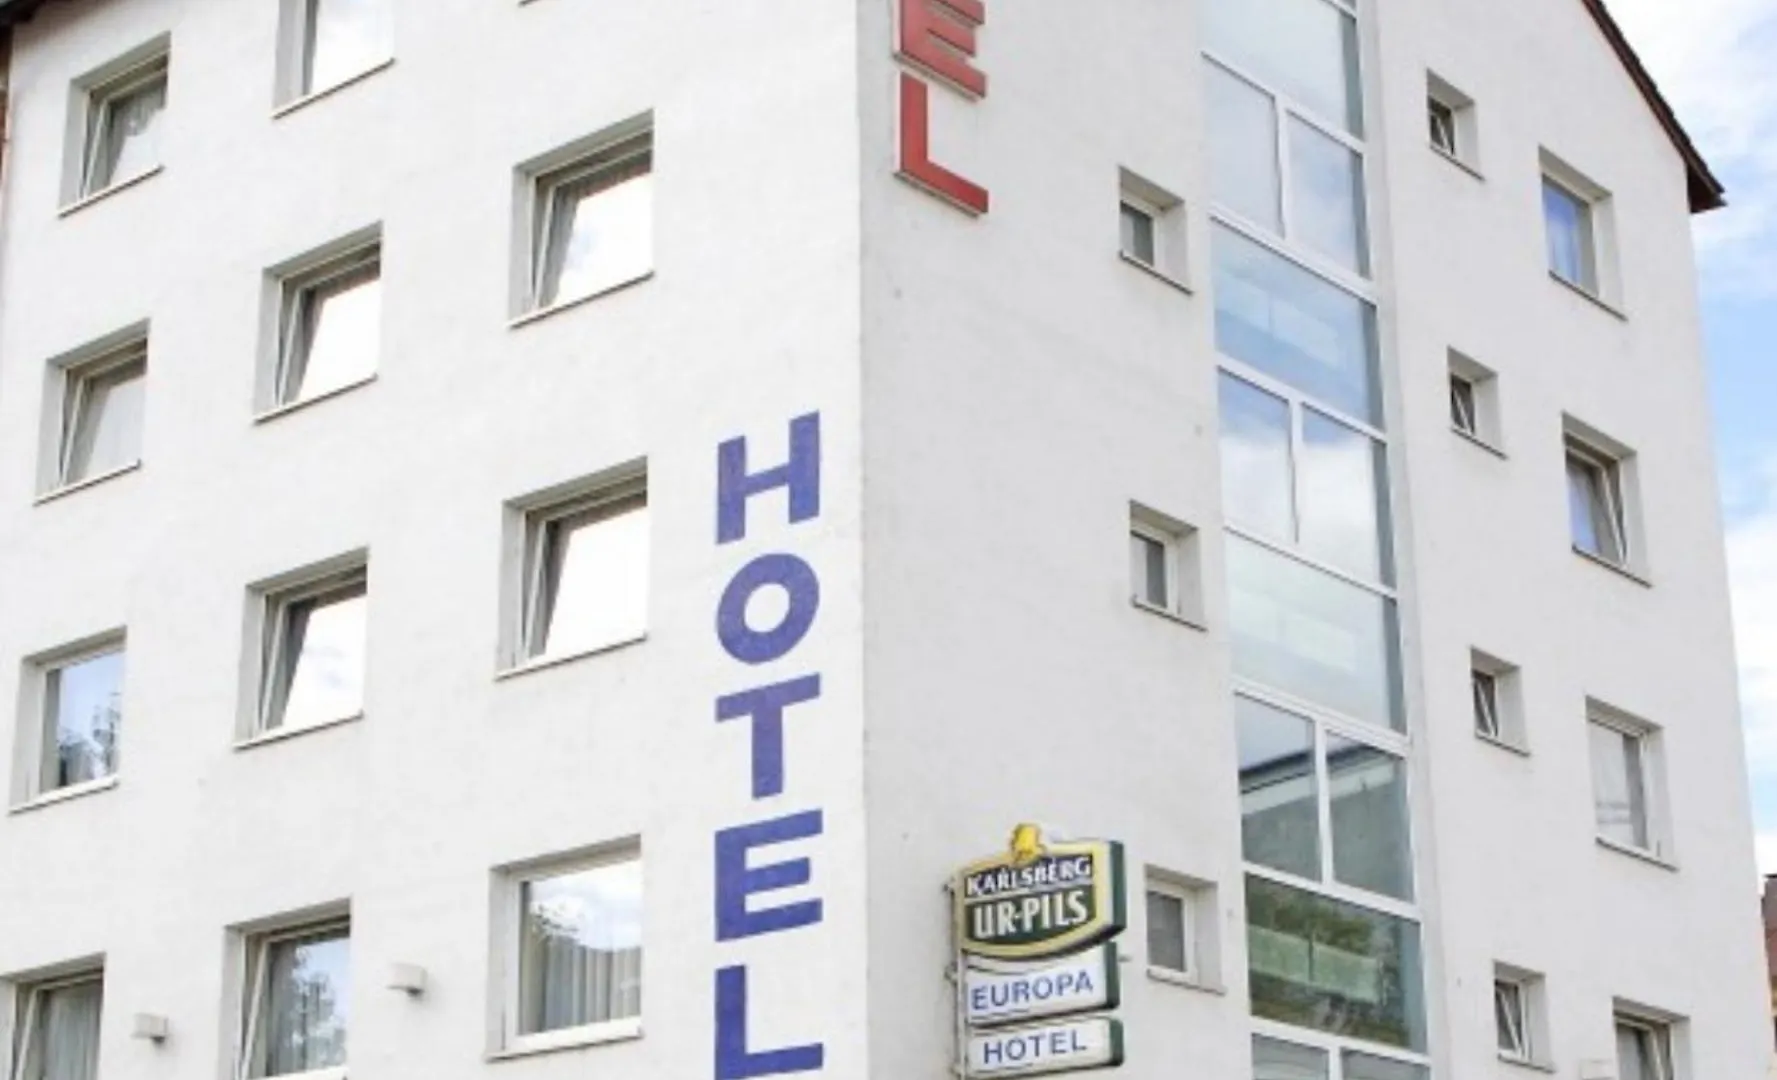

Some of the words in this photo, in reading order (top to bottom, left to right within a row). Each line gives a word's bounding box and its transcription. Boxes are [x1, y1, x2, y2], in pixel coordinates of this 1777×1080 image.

[714, 411, 823, 1080] HOTEL
[967, 856, 1092, 895] KARLSBERG
[973, 889, 1088, 939] UR-PILS
[970, 970, 1094, 1010] EUROPA
[983, 1029, 1088, 1064] HOTEL
